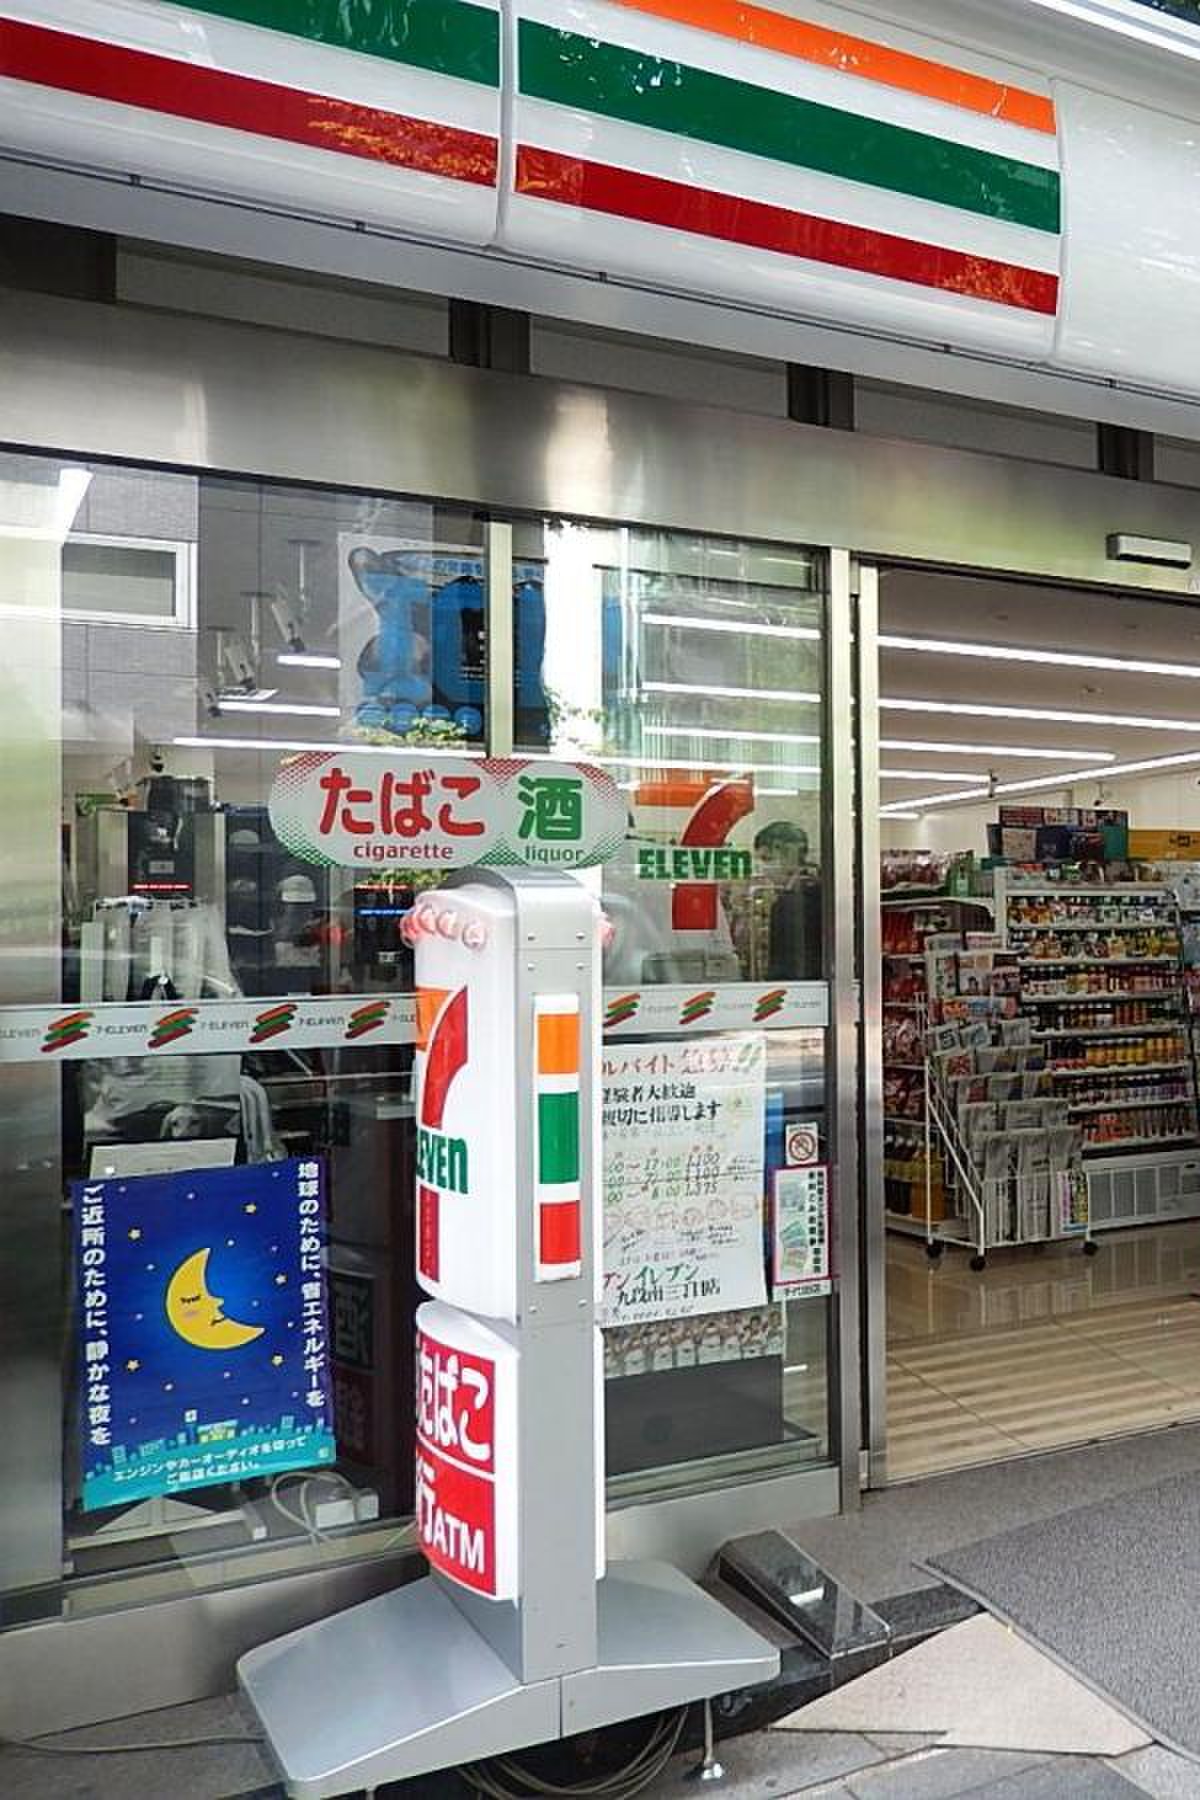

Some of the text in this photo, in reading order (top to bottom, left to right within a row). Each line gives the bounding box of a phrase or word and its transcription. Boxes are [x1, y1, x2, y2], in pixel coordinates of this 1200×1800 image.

[319, 767, 484, 838] たばこ
[517, 775, 584, 841] 酒
[353, 842, 454, 862] cigarette
[525, 845, 582, 863] liquor
[639, 848, 752, 880] ELEVEN
[602, 1056, 675, 1077] ルバイト
[416, 1130, 469, 1195] EVEN
[81, 1183, 113, 1446] ご近所のために、静かな夜を
[298, 1161, 326, 1408] 地球のために、省エネルギーを
